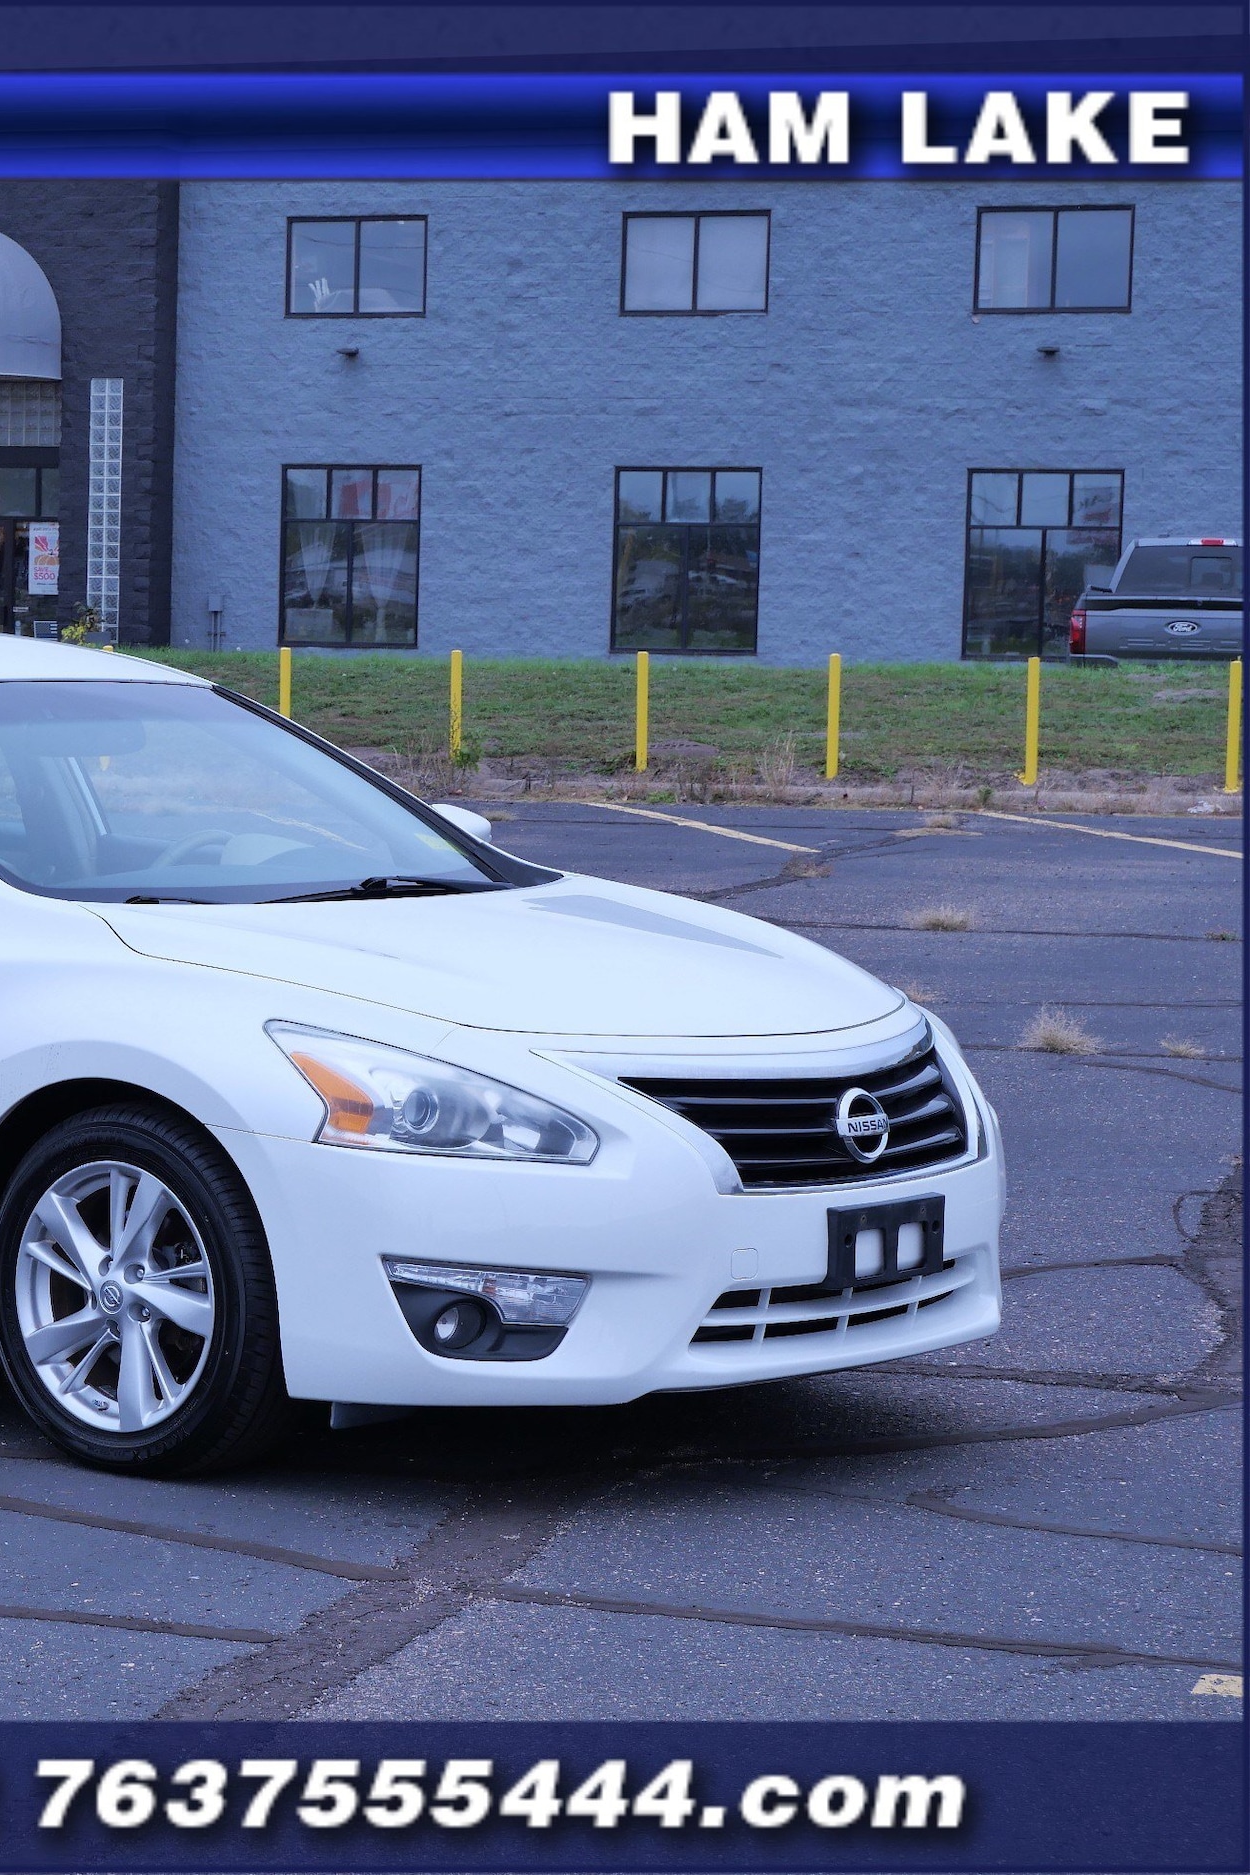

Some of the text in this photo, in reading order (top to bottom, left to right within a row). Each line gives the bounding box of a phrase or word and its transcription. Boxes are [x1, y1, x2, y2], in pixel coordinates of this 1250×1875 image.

[33, 572, 56, 580] $500
[1172, 621, 1194, 632] Ford
[847, 1116, 889, 1134] NISSAN
